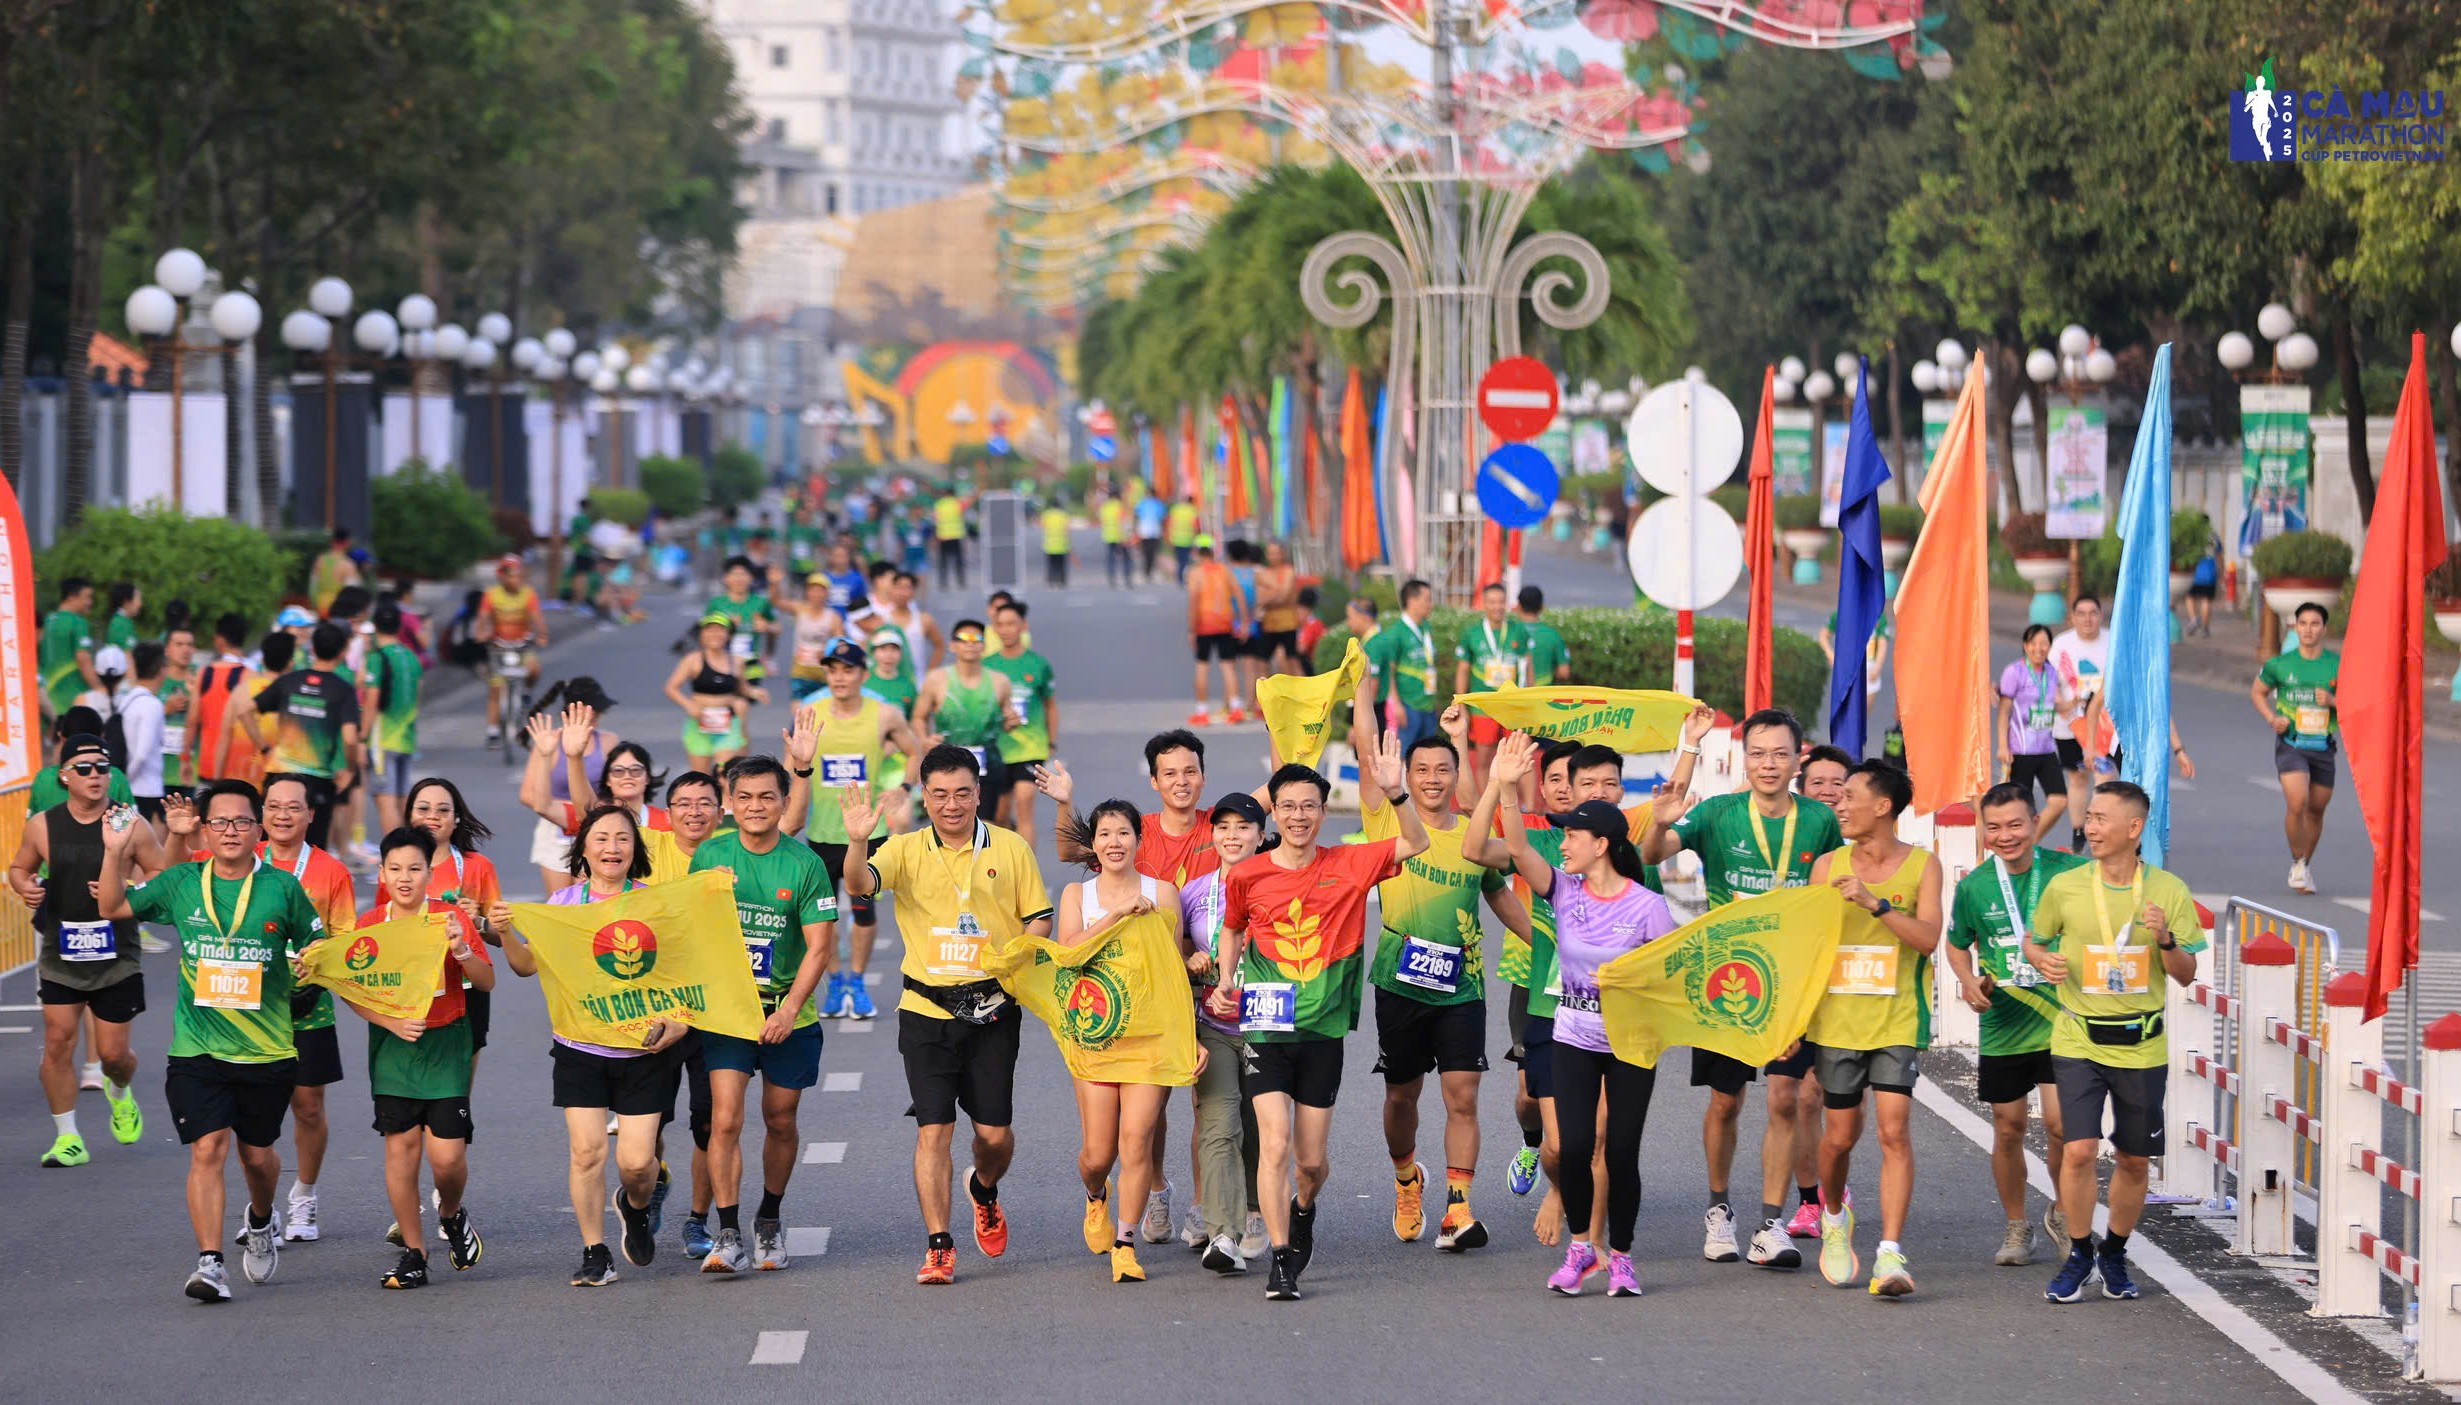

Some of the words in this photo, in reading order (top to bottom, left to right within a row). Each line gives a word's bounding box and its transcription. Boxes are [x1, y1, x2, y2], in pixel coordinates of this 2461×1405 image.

[755, 913, 788, 928] 2025
[66, 932, 108, 950] 22061
[238, 945, 273, 962] 2025
[940, 942, 979, 962] 11127
[1408, 952, 1454, 977] 22189
[209, 974, 249, 995] 11012
[381, 972, 402, 987] MAU
[610, 988, 648, 1021] BÓN
[1246, 997, 1284, 1017] 21491
